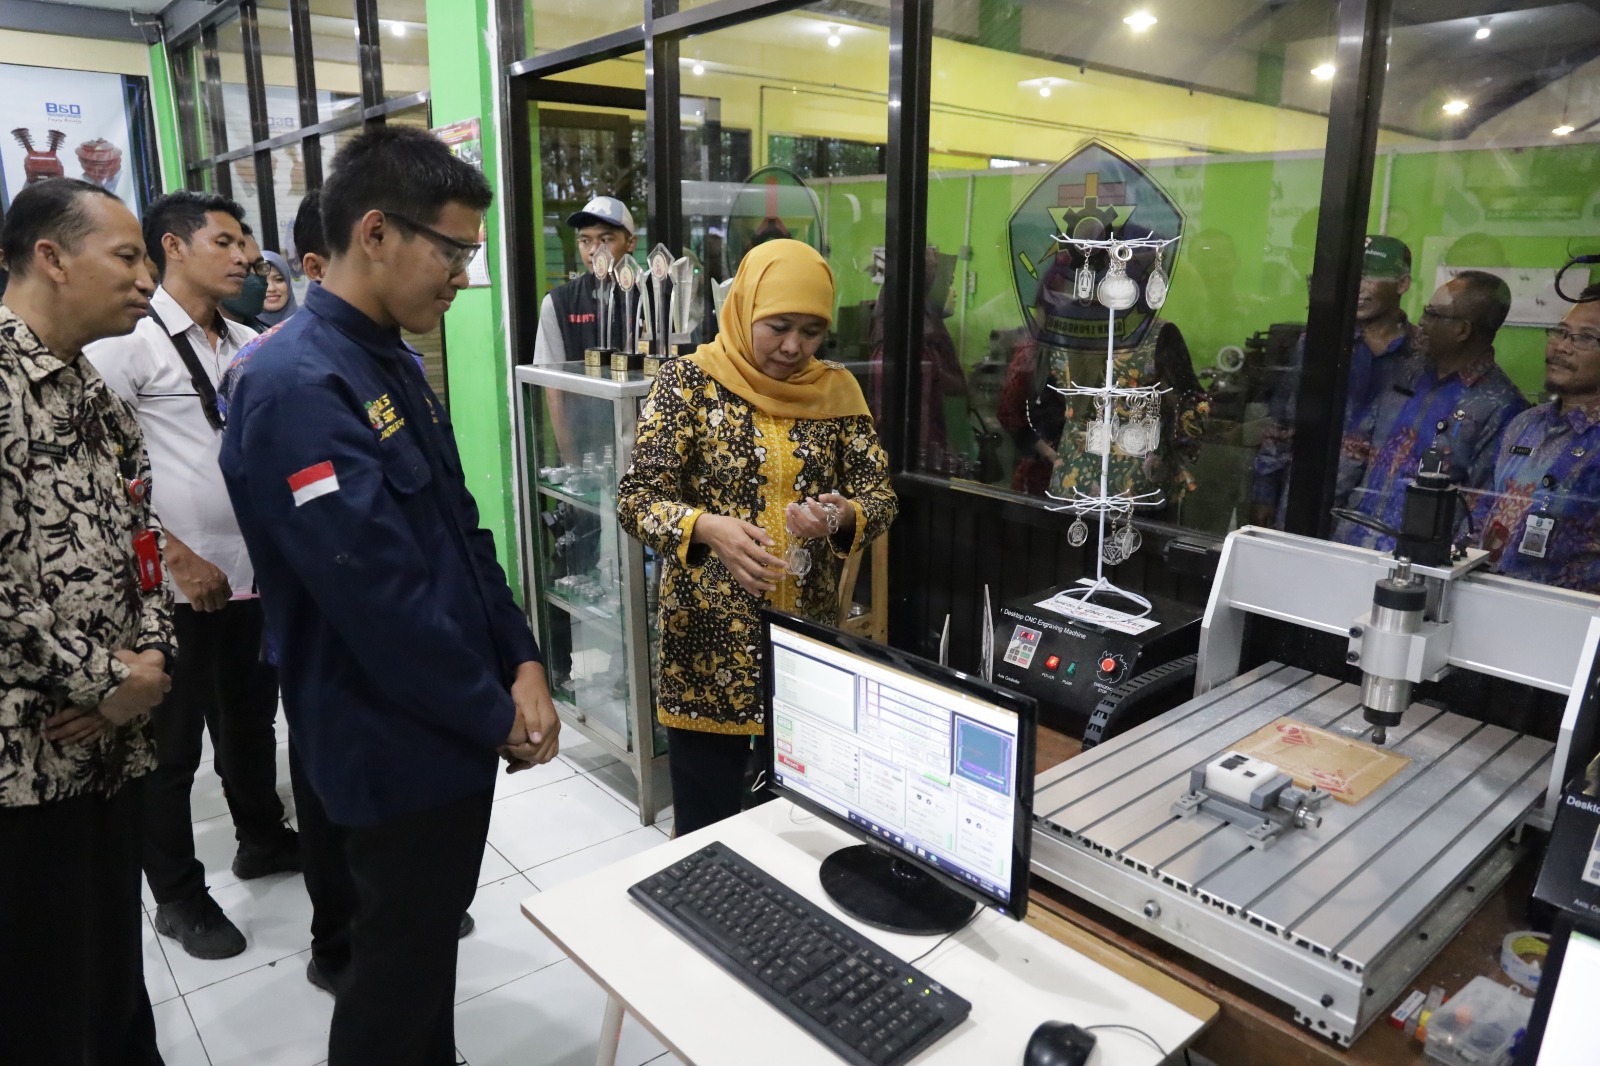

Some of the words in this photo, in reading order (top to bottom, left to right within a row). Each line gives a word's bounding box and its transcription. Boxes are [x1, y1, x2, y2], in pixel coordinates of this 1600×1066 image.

[45, 102, 81, 115] B&D
[1003, 608, 1024, 620] Desktop
[1024, 615, 1037, 624] CNC
[1037, 619, 1064, 634] Engraving
[1063, 627, 1087, 640] Machine
[783, 756, 799, 770] Reset
[1573, 899, 1589, 909] Axis
